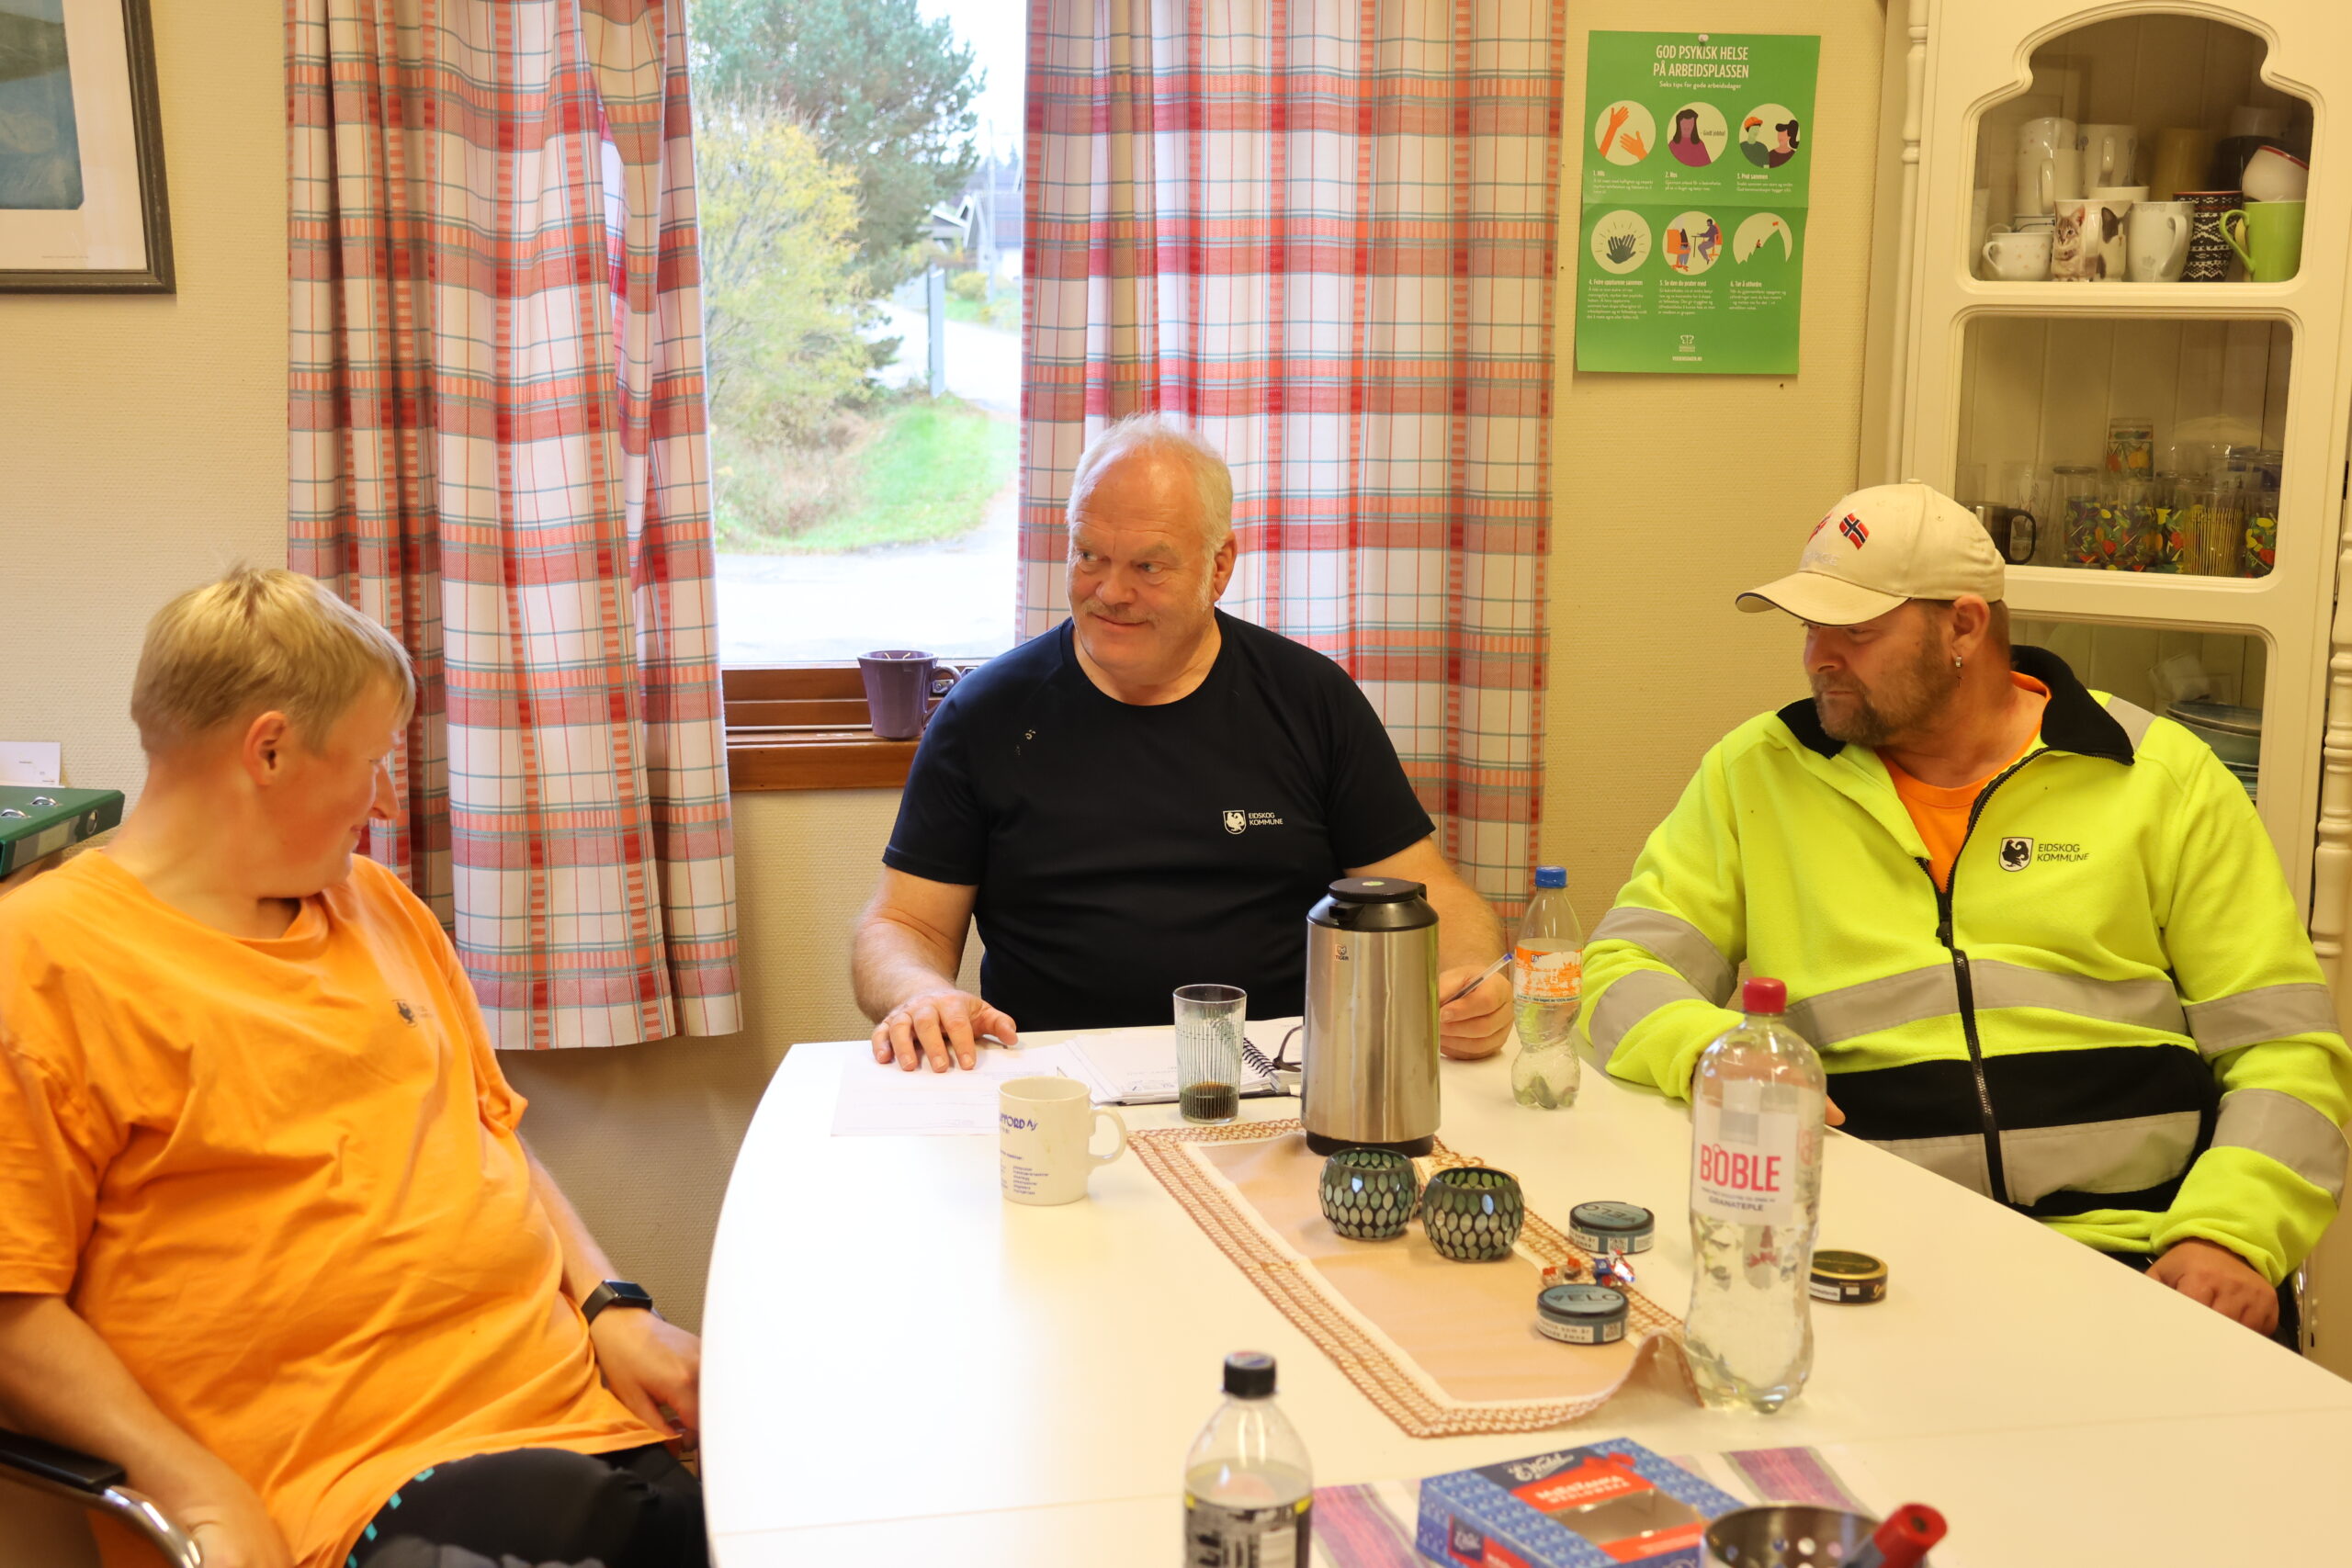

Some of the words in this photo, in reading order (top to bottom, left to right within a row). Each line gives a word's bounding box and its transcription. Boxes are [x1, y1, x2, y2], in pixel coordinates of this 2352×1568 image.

[1656, 45, 1677, 59] GOD
[1679, 45, 1718, 60] PSYKISK
[1720, 46, 1749, 61] HELSE
[1653, 60, 1667, 76] PÅ
[1668, 62, 1749, 78] ARBEIDSPLASSEN
[1692, 82, 1706, 90] gode
[1707, 83, 1742, 91] arbeidsdager
[2038, 843, 2080, 852] EIDSKOG
[2037, 853, 2090, 863] KOMMUNE
[1701, 1144, 1781, 1191] BOBLE
[1708, 1195, 1764, 1212] GRANATEPLE
[1547, 1293, 1622, 1303] VELO
